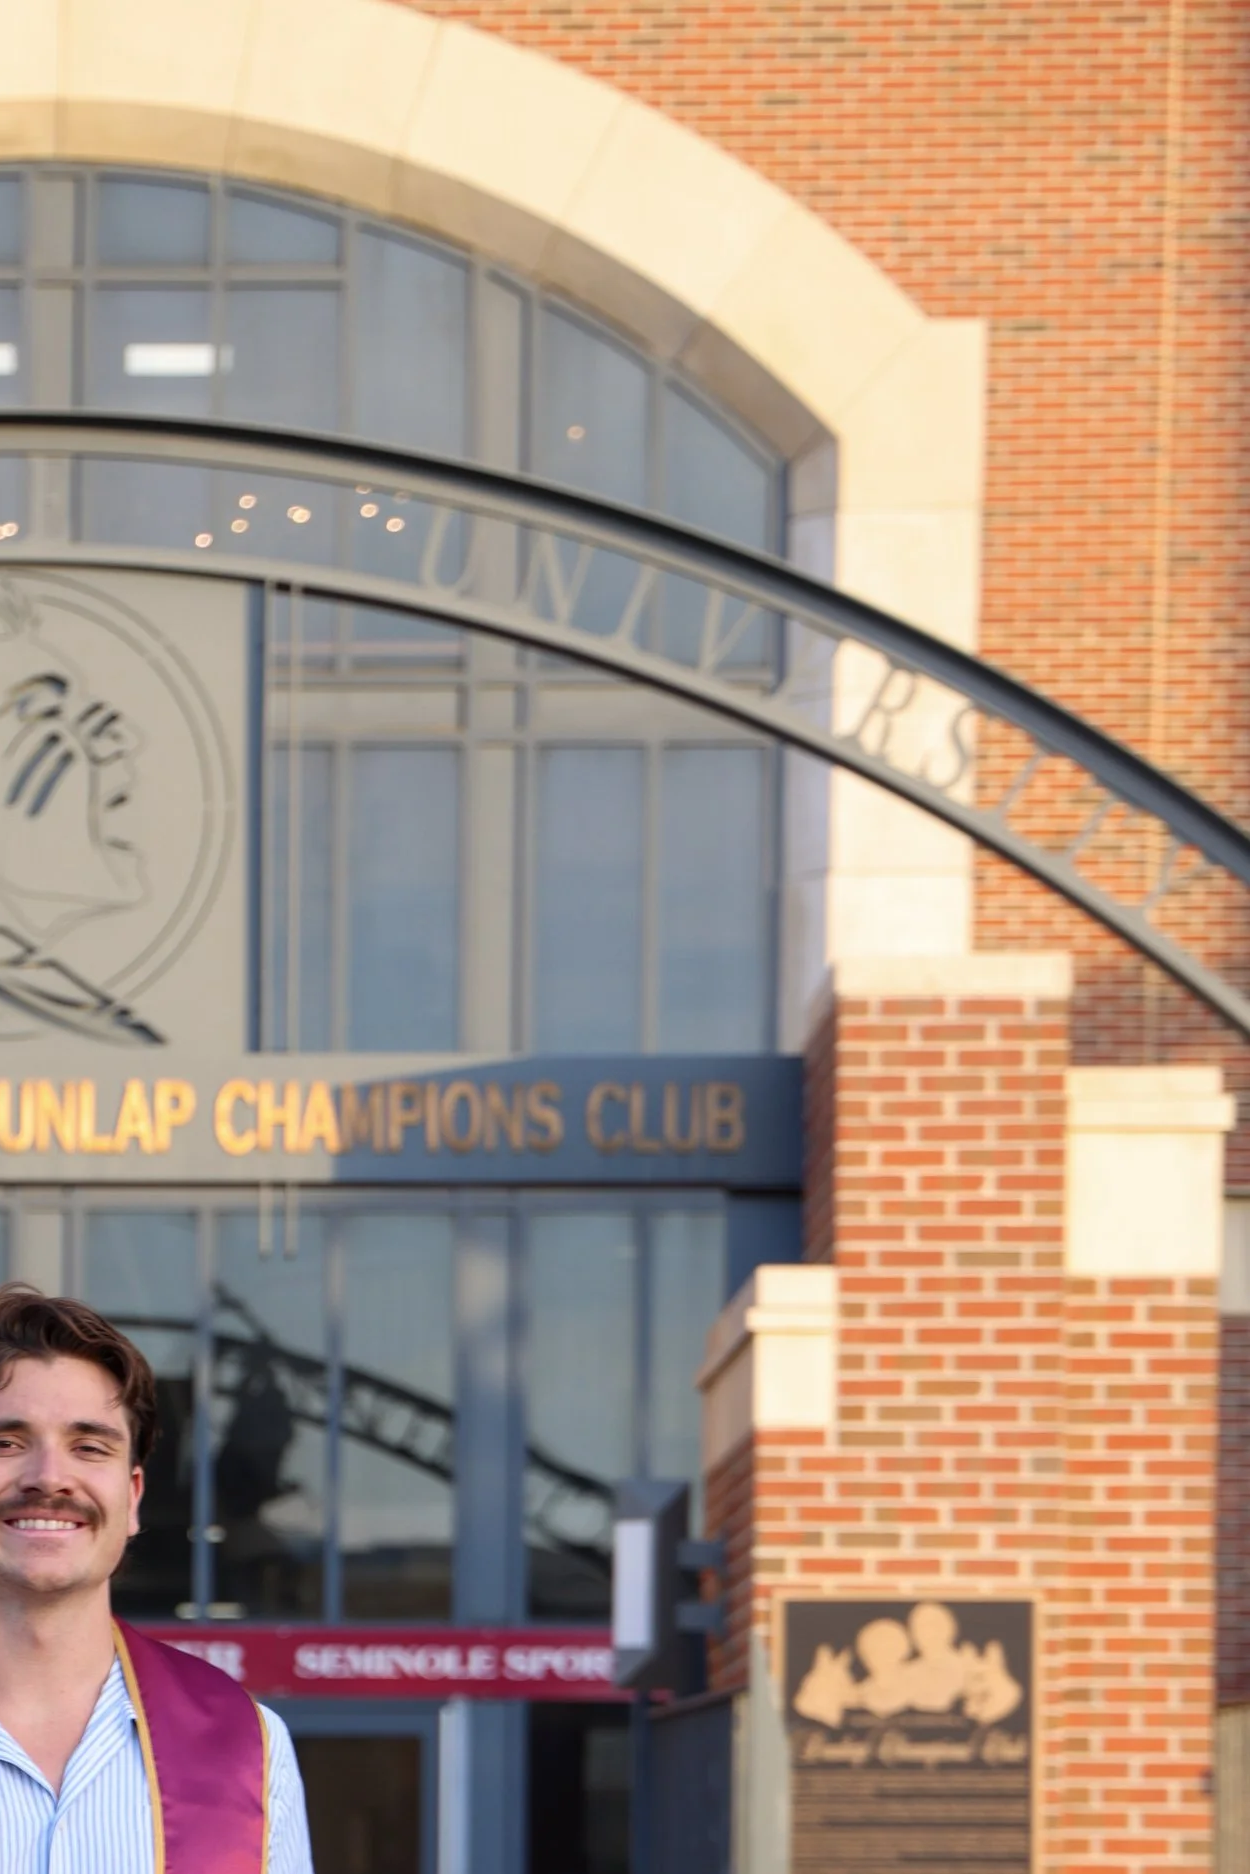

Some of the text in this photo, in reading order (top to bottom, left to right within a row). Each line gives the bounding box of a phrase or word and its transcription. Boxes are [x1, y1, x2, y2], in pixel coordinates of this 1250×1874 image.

[213, 1078, 565, 1156] CHAMPIONS
[585, 1080, 746, 1155] CLUB
[295, 1642, 612, 1681] SEMINOLE SPOR
